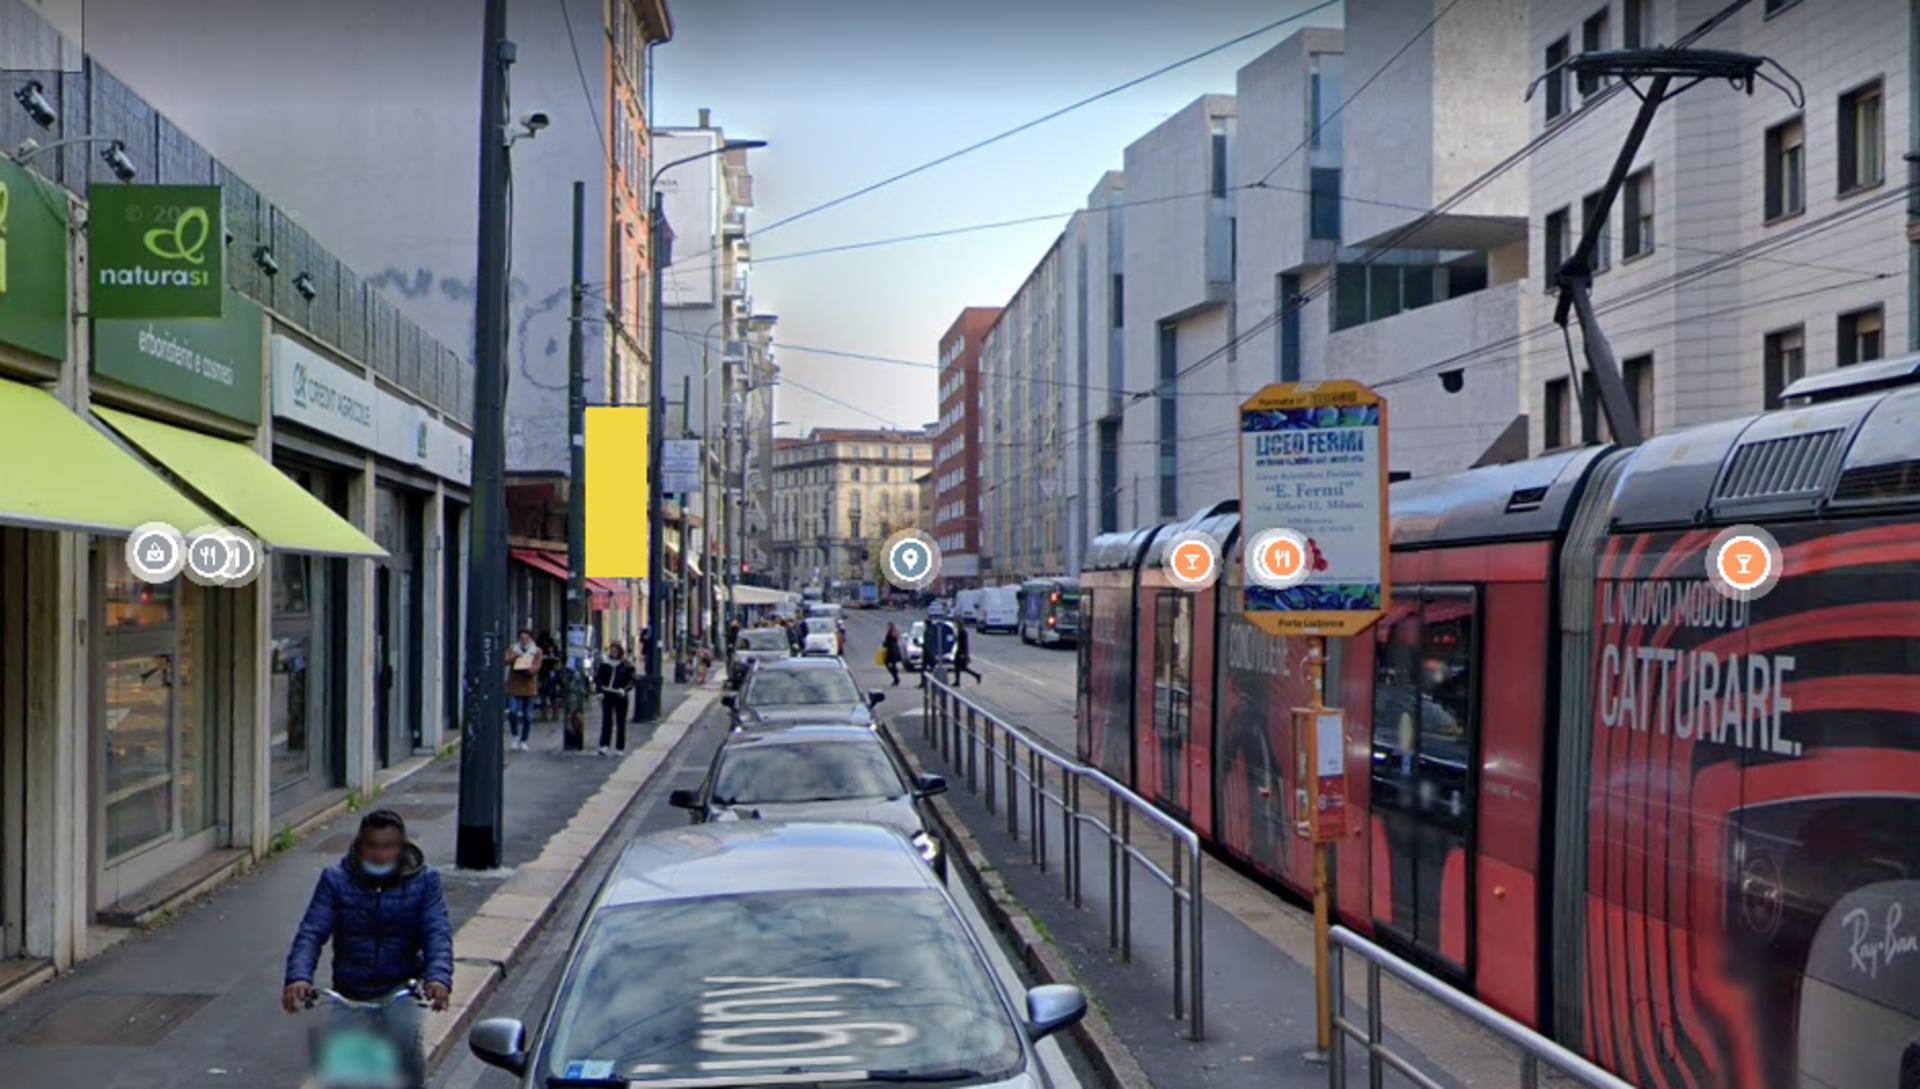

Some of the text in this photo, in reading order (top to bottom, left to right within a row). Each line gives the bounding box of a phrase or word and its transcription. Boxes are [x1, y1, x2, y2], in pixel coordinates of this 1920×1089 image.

[100, 266, 209, 287] naturasi
[1255, 430, 1365, 457] LICEO FERMI
[1602, 580, 1614, 625] IL
[1618, 581, 1671, 626] NUOVO
[1674, 580, 1728, 628] MODO
[1278, 618, 1302, 628] Porta
[1600, 643, 1803, 757] CATTURARE.
